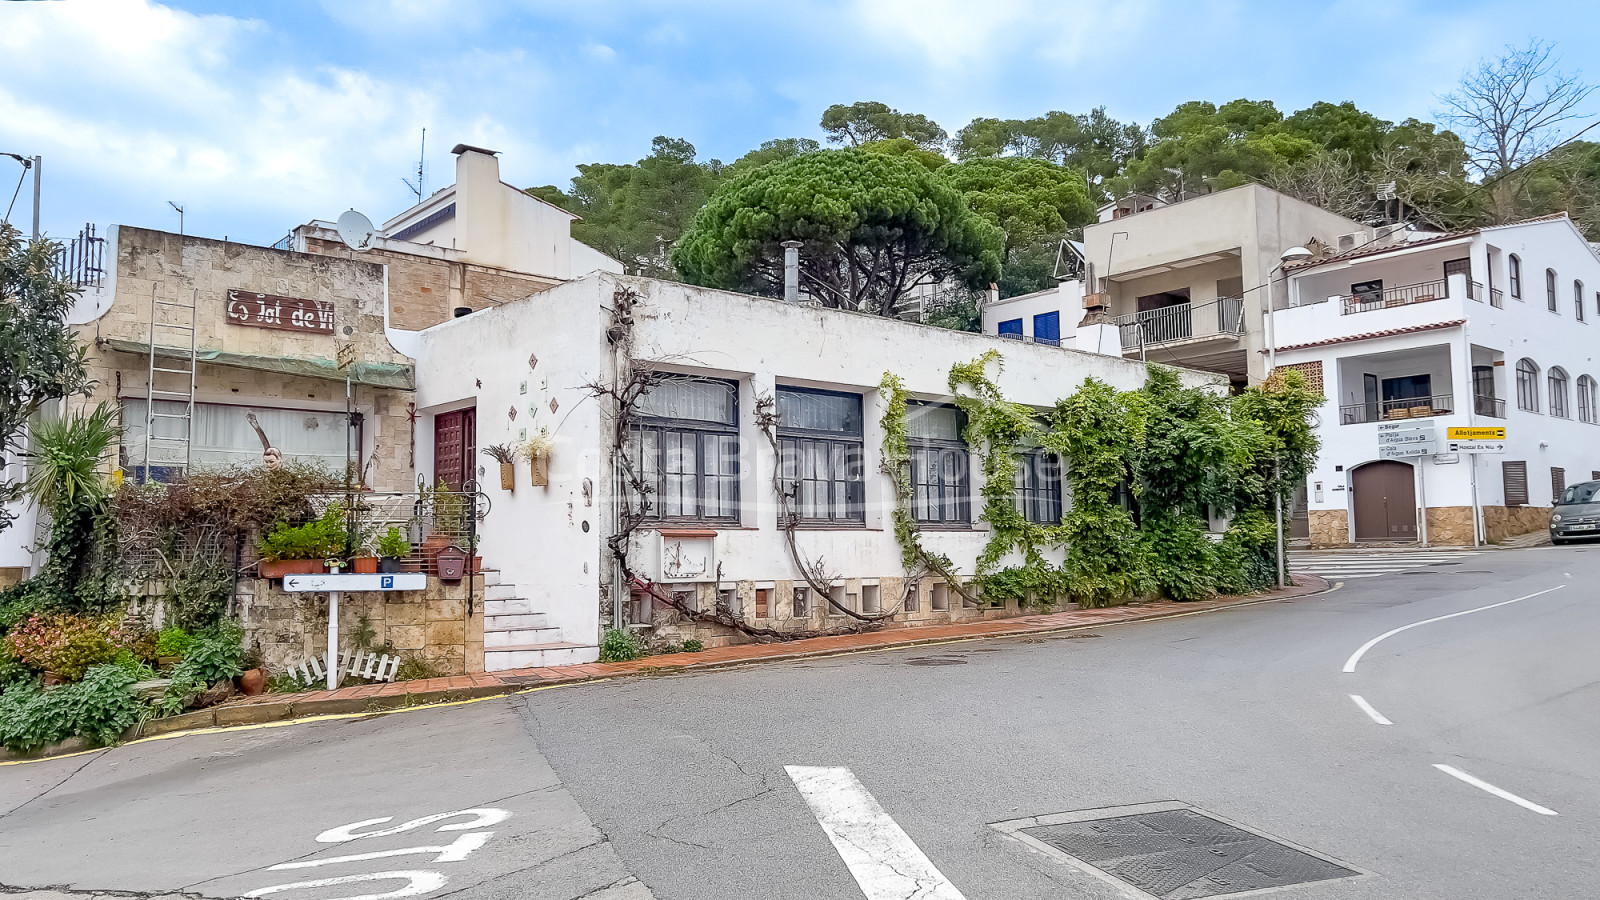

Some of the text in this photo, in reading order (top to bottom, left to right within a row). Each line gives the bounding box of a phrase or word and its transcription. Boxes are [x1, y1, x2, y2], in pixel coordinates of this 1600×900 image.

[291, 302, 315, 328] de
[313, 300, 334, 329] Vi
[1454, 429, 1496, 437] Allotjaments
[383, 577, 392, 587] P
